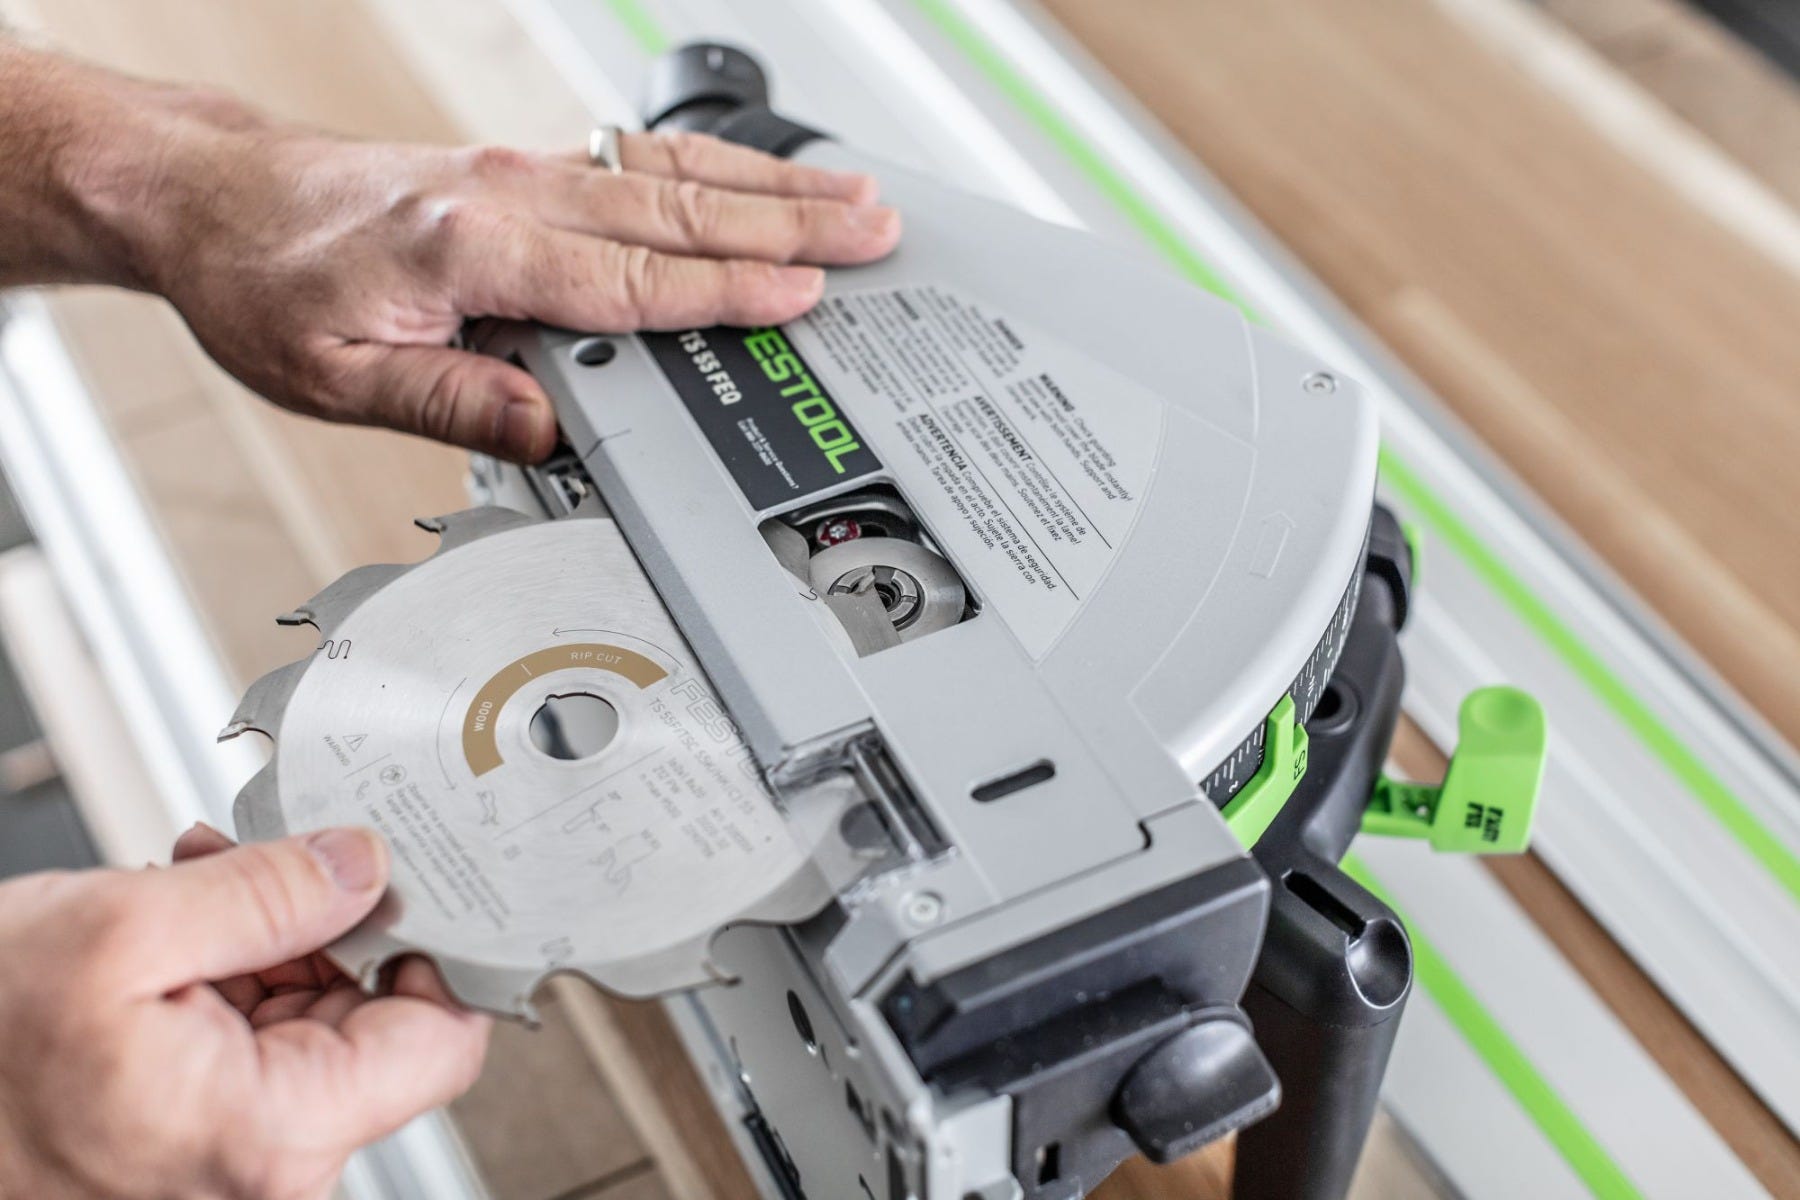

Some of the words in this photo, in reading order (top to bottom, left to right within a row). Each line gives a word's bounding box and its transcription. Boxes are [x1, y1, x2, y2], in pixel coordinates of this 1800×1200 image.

[742, 324, 861, 475] ESTOOL
[1037, 373, 1076, 412] WARNING
[1073, 417, 1096, 438] Check
[1087, 437, 1118, 467] guarding
[917, 412, 969, 472] ADVERTENCIA
[928, 465, 950, 486] Tarea
[937, 460, 963, 486] espada
[972, 394, 1033, 462] AVERTISSEMENT
[1051, 498, 1081, 527] système
[1073, 525, 1089, 536] de
[1077, 459, 1107, 487] Support
[1099, 485, 1117, 500] and
[1087, 452, 1108, 471] blade
[1101, 470, 1133, 502] instantly!
[942, 484, 956, 495] de
[956, 484, 969, 495] en
[958, 470, 997, 510] Compruebe
[963, 493, 976, 502] el
[947, 494, 969, 516] apoyo
[969, 501, 989, 519] acto.
[989, 508, 1002, 517] el
[1015, 487, 1046, 518] Soutenez
[980, 517, 1007, 542] Sujete
[995, 516, 1023, 545] sistema
[1038, 516, 1051, 526] et
[1053, 517, 1066, 526] la
[966, 518, 998, 551] sujeción.
[998, 539, 1012, 549] la
[1044, 524, 1065, 542] fixez
[1059, 524, 1082, 546] lame!
[1004, 548, 1027, 571] sierra
[1015, 543, 1031, 554] de
[1020, 570, 1037, 585] con
[1021, 552, 1059, 592] seguridad.
[570, 651, 592, 661] RIP
[596, 652, 623, 665] CUT
[474, 700, 493, 732] WOOD
[646, 697, 667, 715] TS
